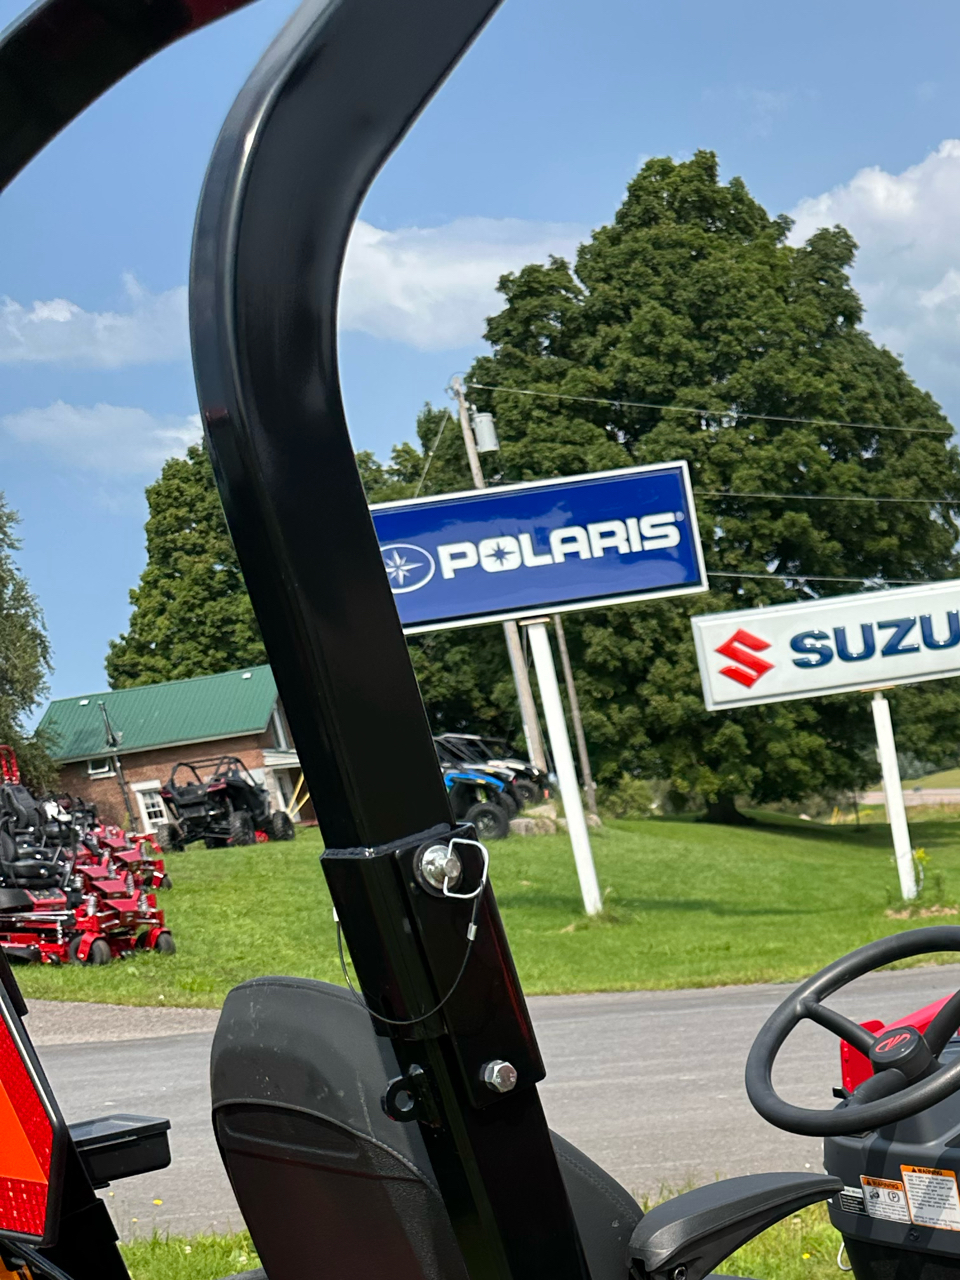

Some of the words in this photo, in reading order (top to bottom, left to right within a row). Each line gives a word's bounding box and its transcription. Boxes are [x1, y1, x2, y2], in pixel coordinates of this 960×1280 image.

[437, 512, 681, 579] POLARIS
[917, 1168, 943, 1176] WARNING
[872, 1179, 899, 1190] WARNING
